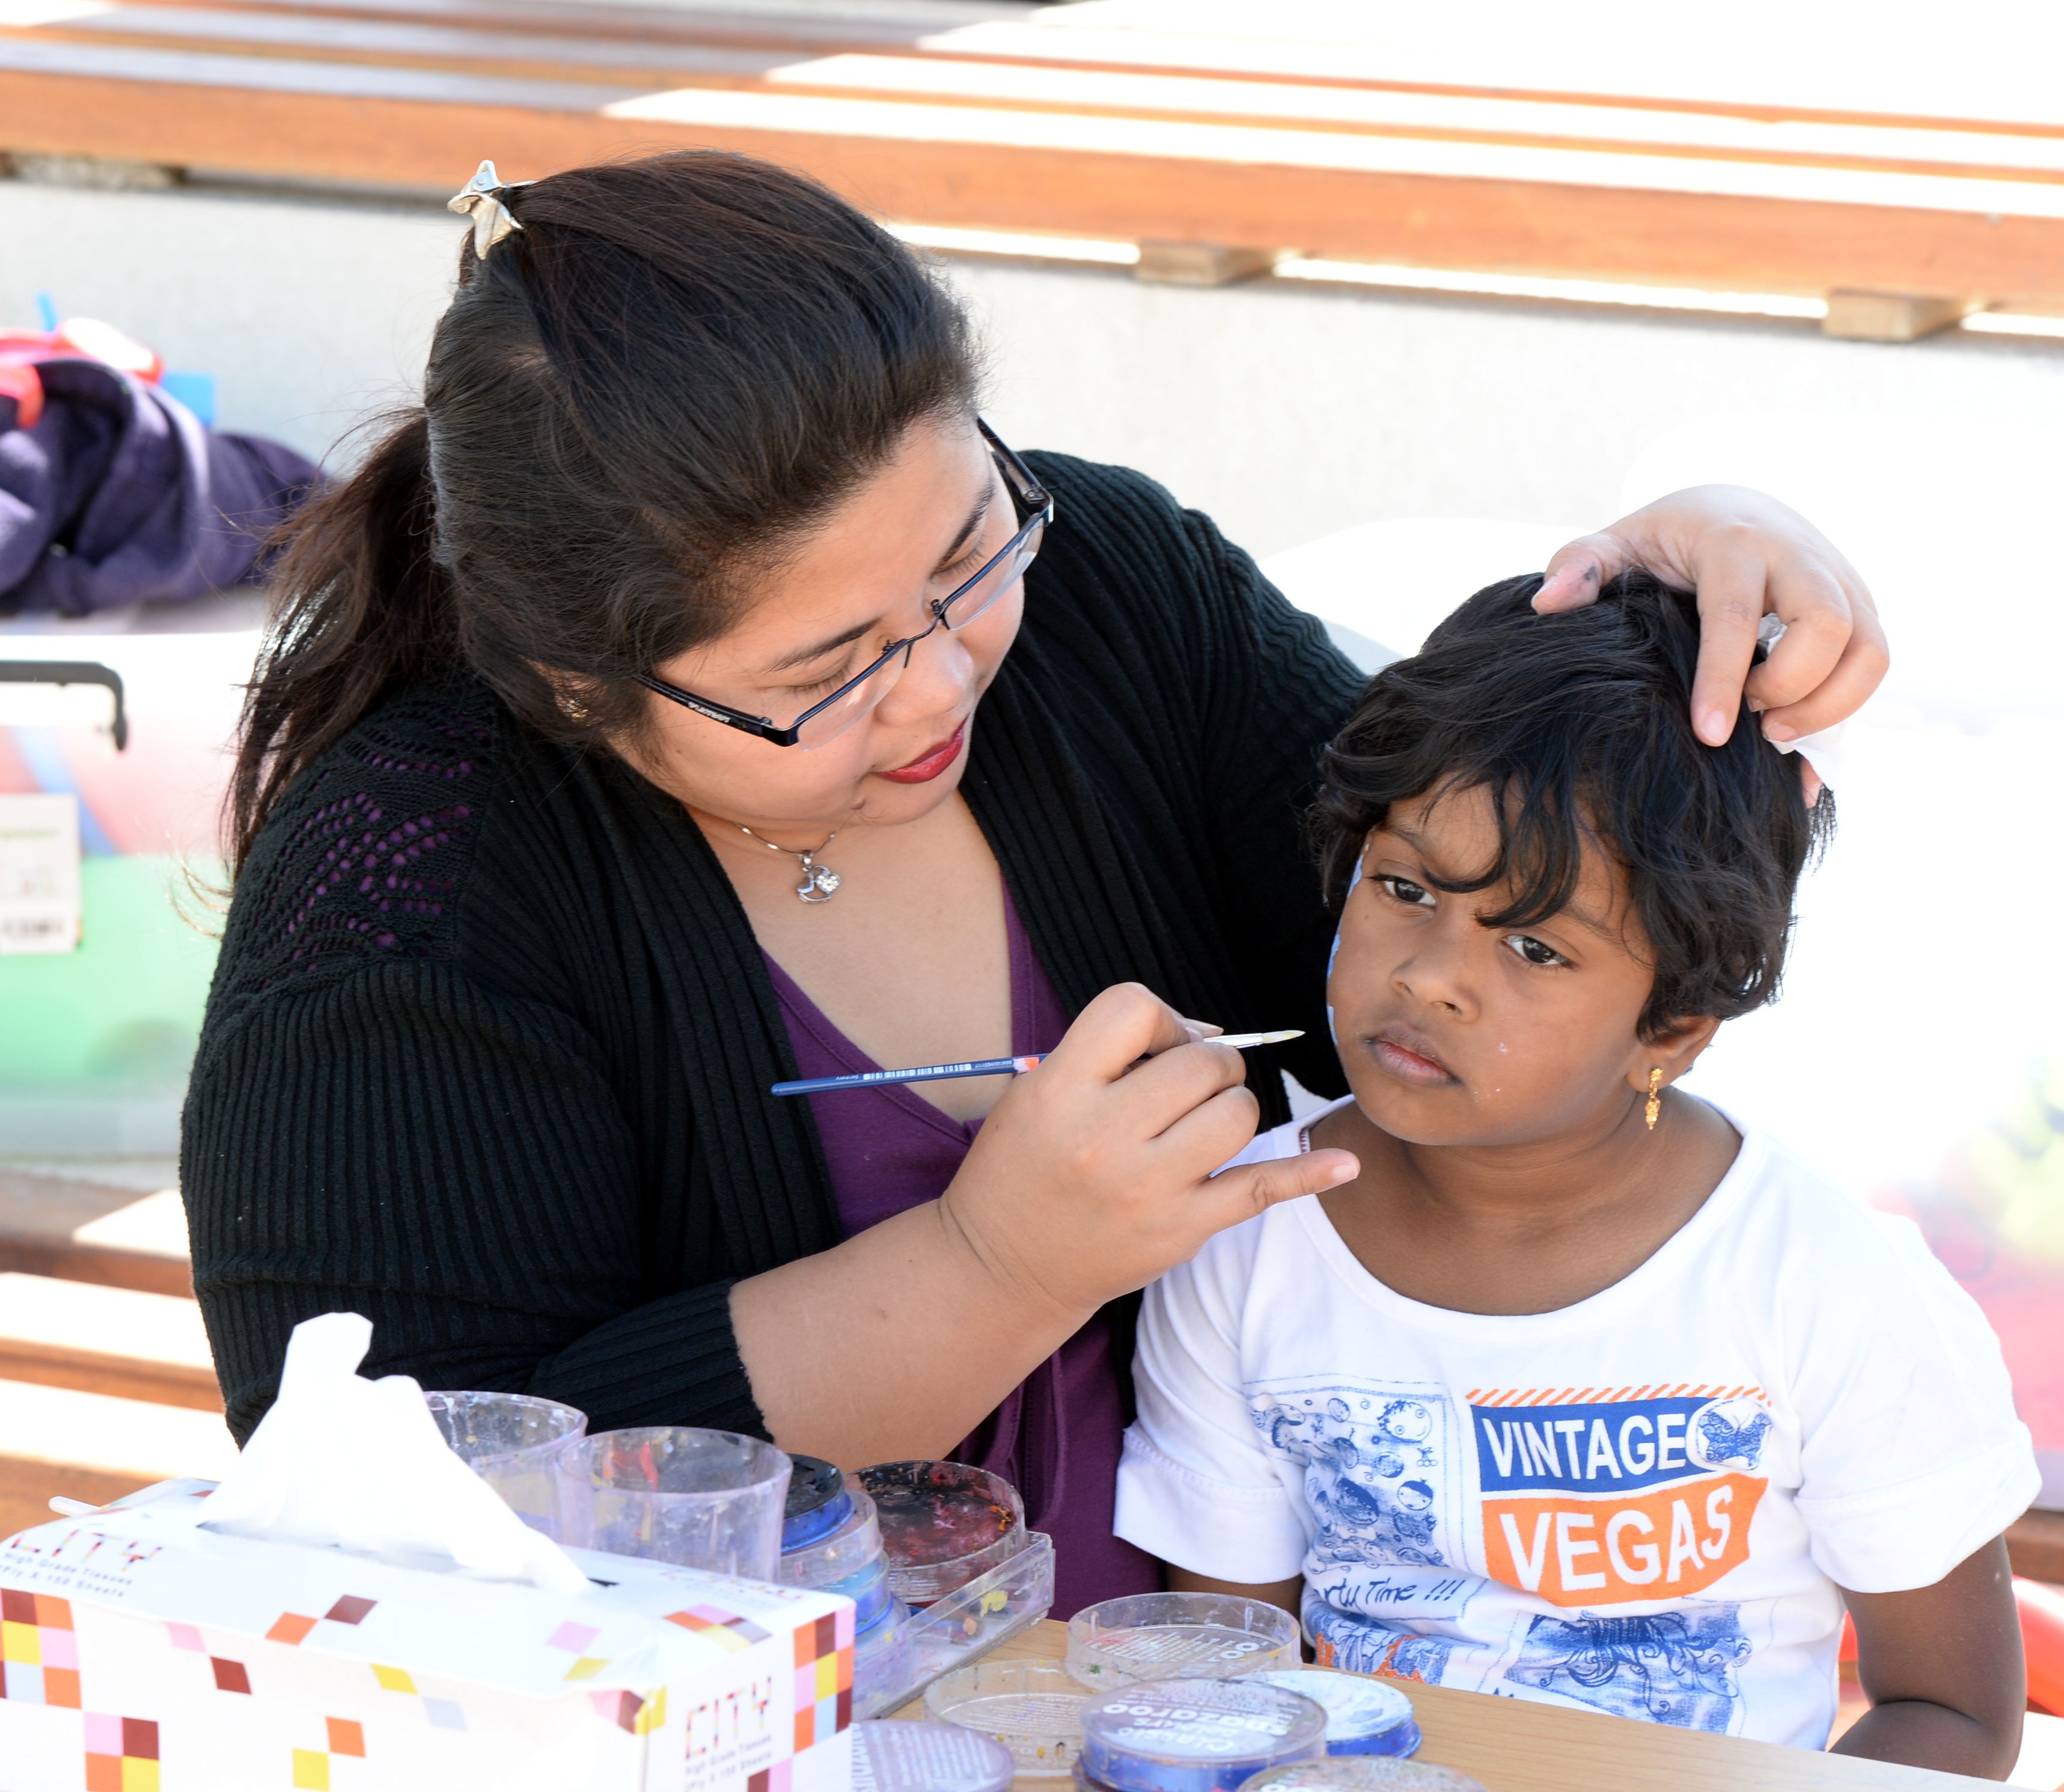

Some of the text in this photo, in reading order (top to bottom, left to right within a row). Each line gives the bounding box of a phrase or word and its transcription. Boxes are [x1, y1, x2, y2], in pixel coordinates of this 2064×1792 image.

[1482, 1413, 1686, 1480] VINTAGE
[1500, 1484, 1733, 1592] VEGAS
[1365, 1577, 1417, 1605] Time
[1424, 1579, 1467, 1602] !!!
[685, 1676, 772, 1760] CITY
[1102, 1703, 1289, 1737] snazaroo
[1116, 1726, 1234, 1754] Classic
